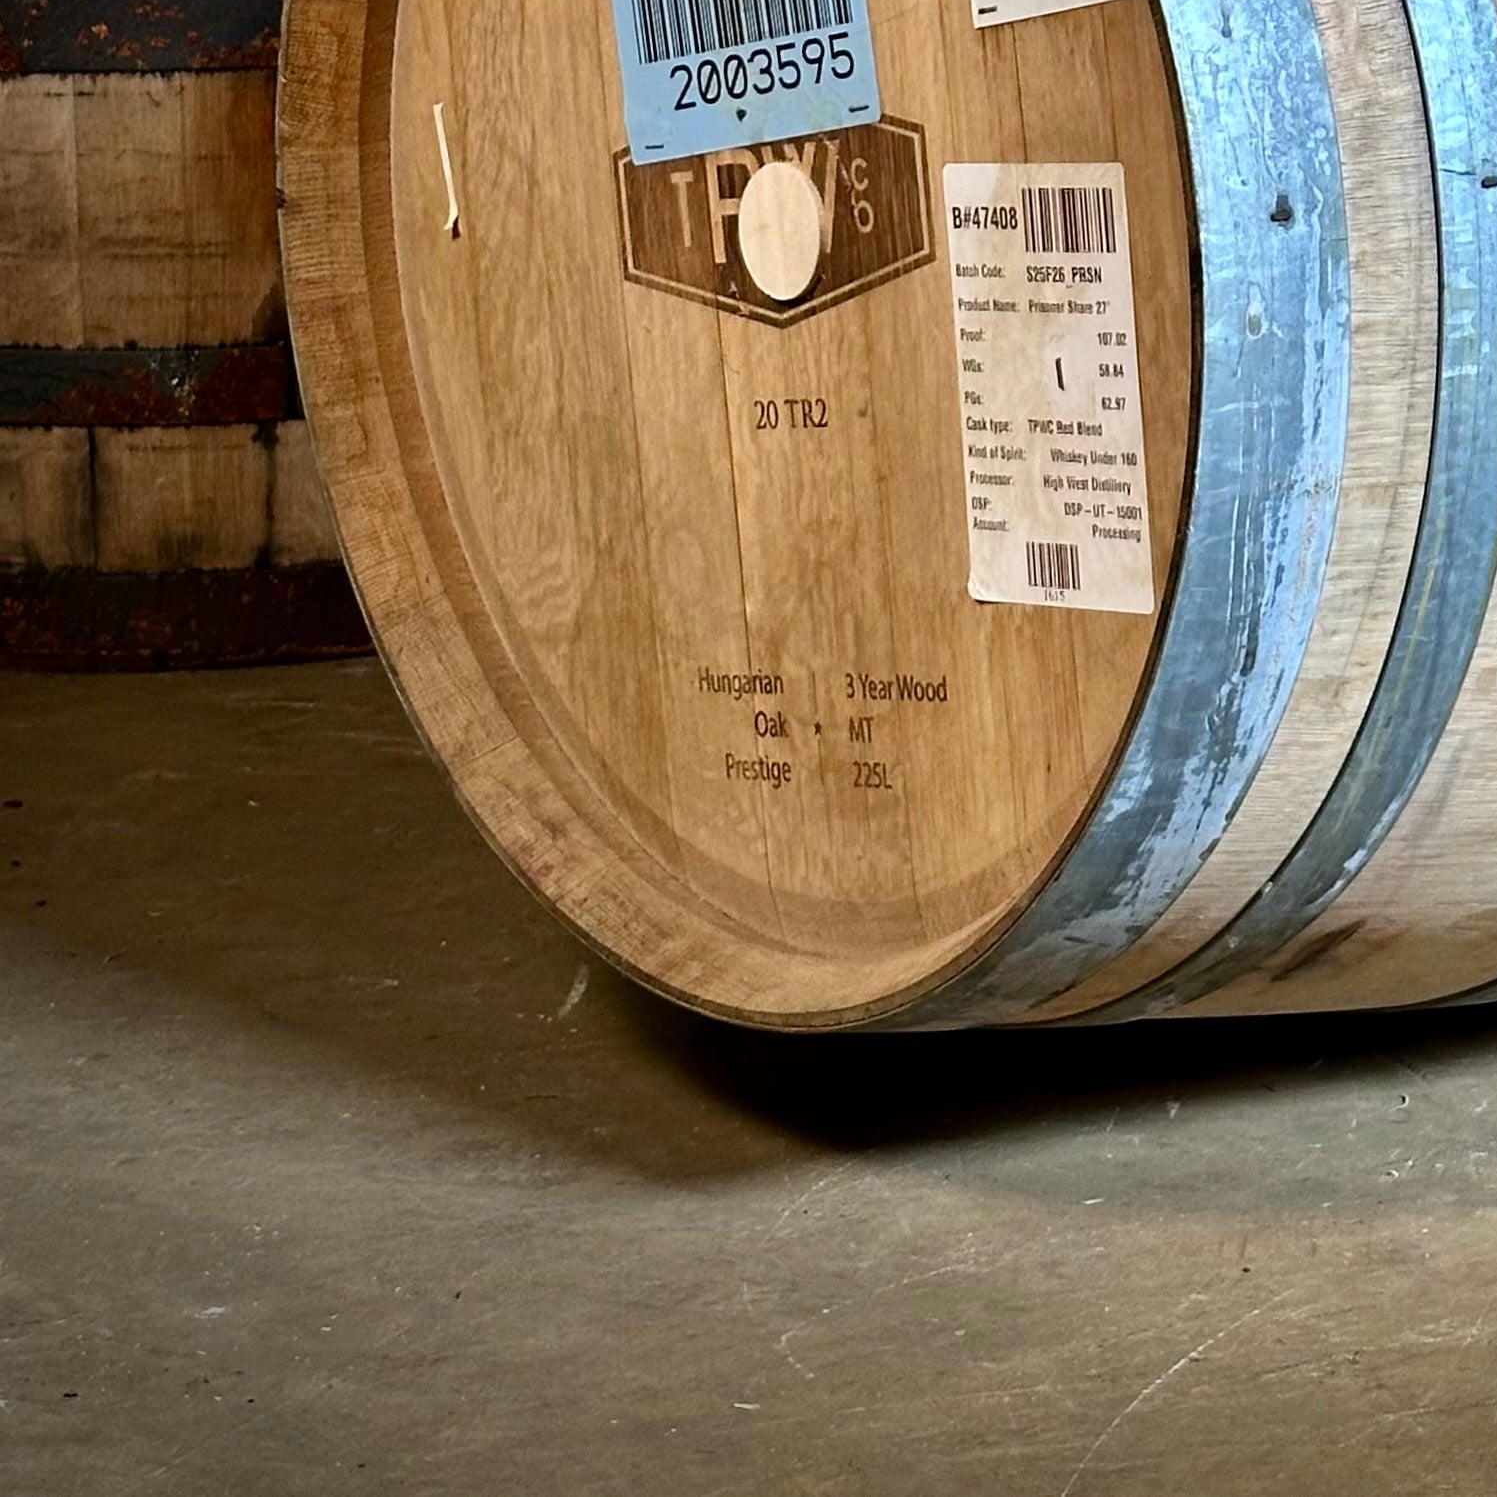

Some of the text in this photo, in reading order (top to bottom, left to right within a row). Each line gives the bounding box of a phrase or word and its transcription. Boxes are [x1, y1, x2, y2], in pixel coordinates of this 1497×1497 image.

[670, 31, 855, 111] 2003595
[952, 206, 1018, 230] B#47408
[956, 264, 979, 277] Batch
[981, 264, 1006, 278] Code:
[958, 298, 991, 311] Product
[993, 299, 1020, 312] Name:
[960, 328, 986, 342] Proof:
[754, 398, 829, 430] 20 TR2
[966, 416, 987, 431] Cask
[989, 418, 1012, 434] type:
[1076, 421, 1103, 436] Blend
[968, 446, 988, 460] Kind
[989, 446, 1000, 460] of
[1000, 446, 1027, 462] Spirit:
[1043, 474, 1064, 491] High
[1066, 476, 1089, 490] West
[1092, 524, 1142, 543] Processing
[698, 667, 784, 701] Hungarian
[845, 672, 948, 702] 3 Year Wood
[754, 710, 788, 738] Oak
[848, 716, 875, 743] MT
[725, 752, 792, 790] Prestige
[852, 761, 893, 789] 225L
